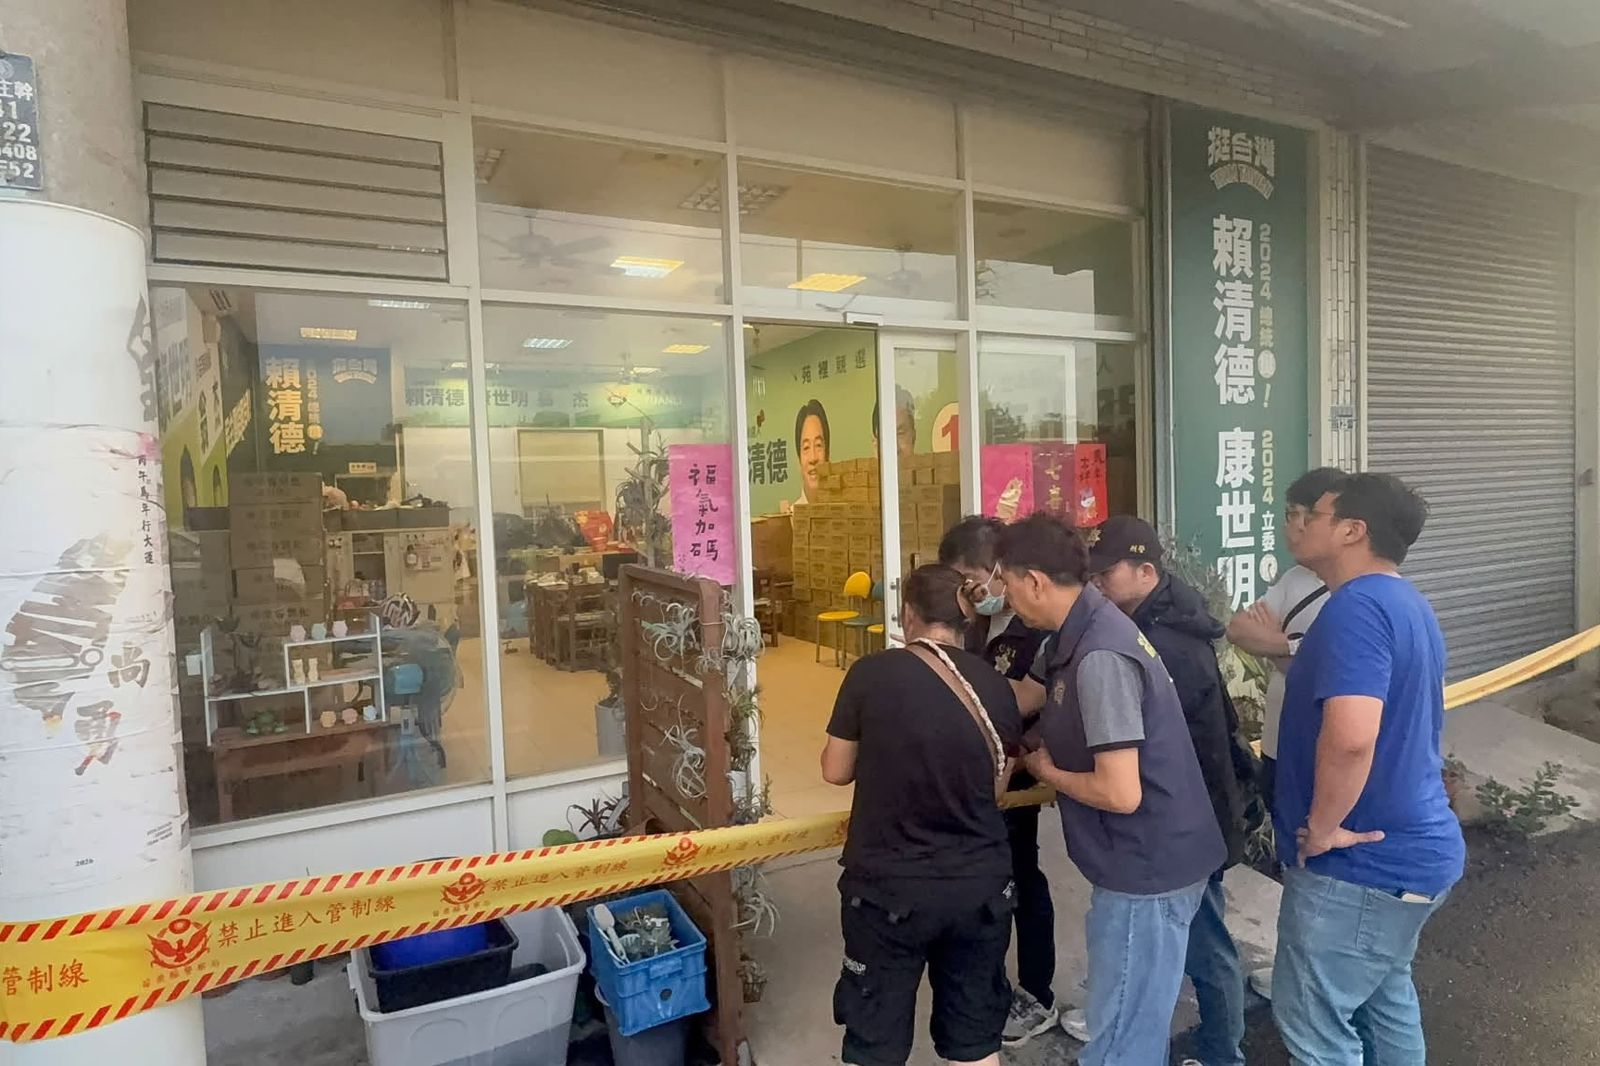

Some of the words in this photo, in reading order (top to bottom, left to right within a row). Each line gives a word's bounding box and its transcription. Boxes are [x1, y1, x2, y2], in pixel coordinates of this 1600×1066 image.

[0, 142, 38, 161] 408
[1259, 223, 1273, 300] 2024
[1211, 213, 1255, 405] 賴清德
[265, 356, 306, 455] 賴清德
[484, 387, 529, 408] 世明
[747, 437, 788, 485] 清德
[1261, 430, 1274, 505] 2024
[688, 463, 719, 561] 福氣加碼
[1215, 426, 1256, 613] 康世明
[218, 898, 397, 948] 禁止進入管制線
[2, 958, 90, 996] 管制線
